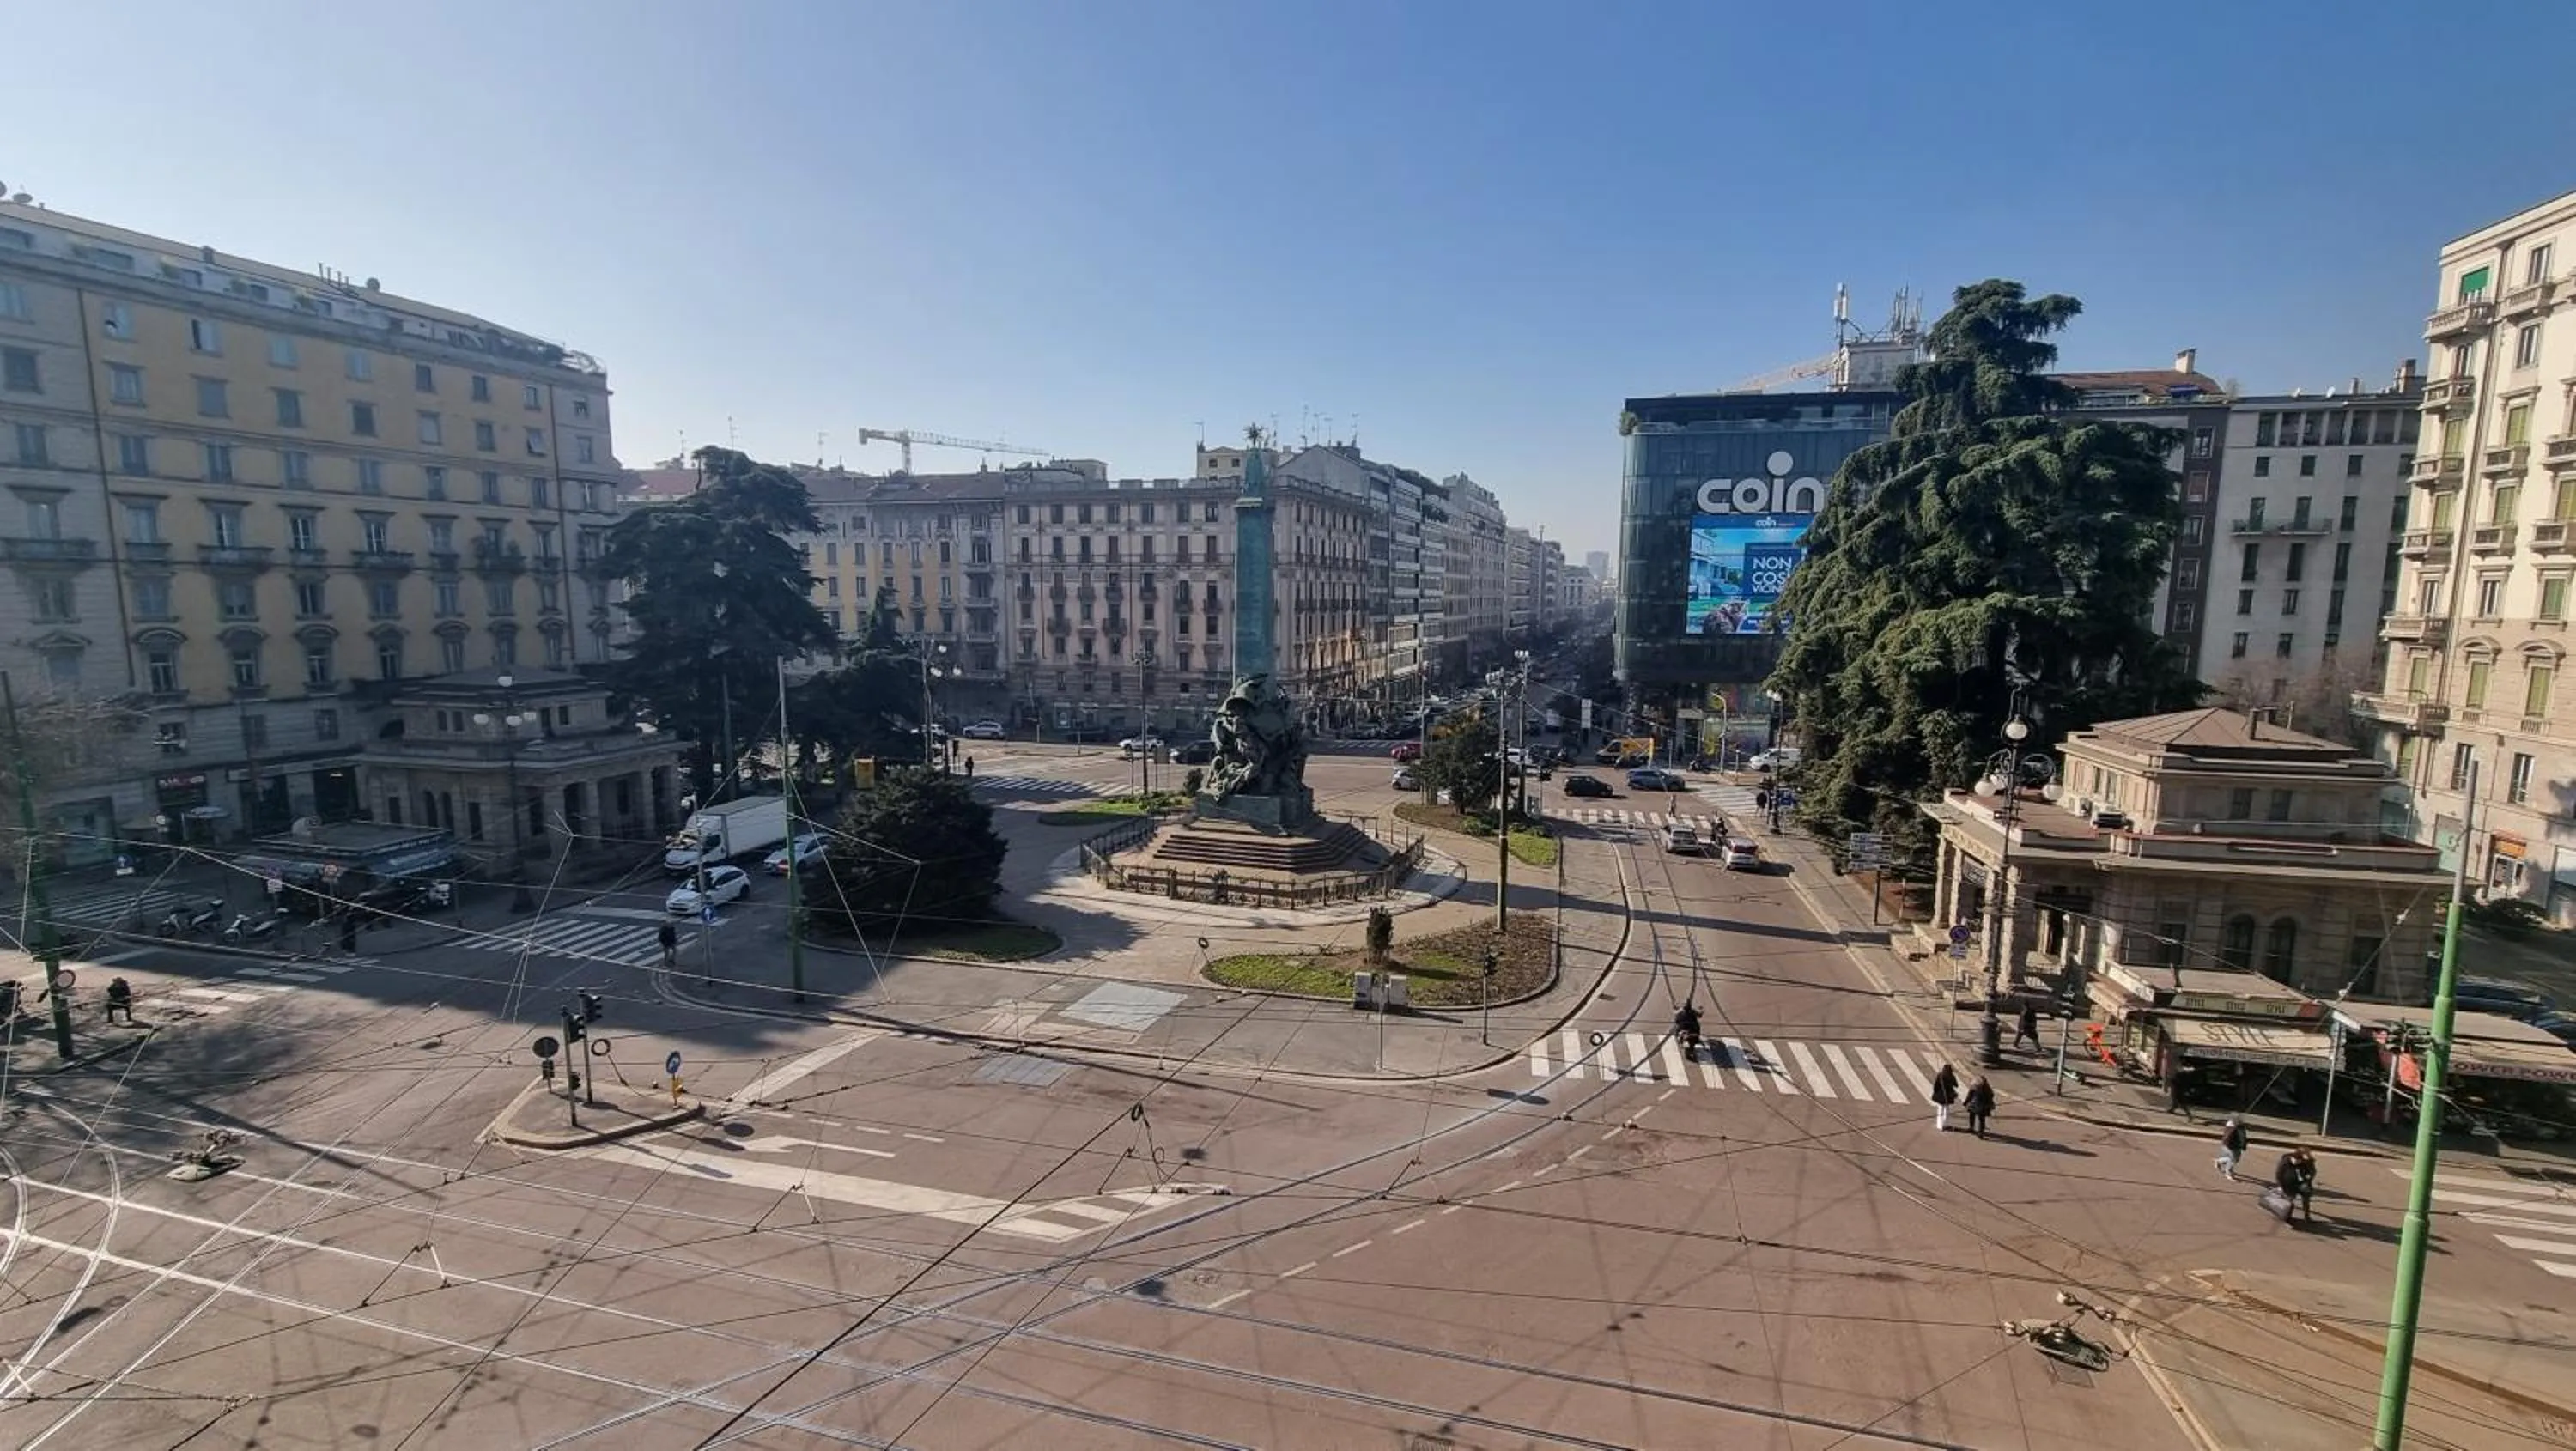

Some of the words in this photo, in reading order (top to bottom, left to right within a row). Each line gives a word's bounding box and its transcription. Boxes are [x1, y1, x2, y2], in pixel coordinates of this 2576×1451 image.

[1697, 451, 1825, 513] coin
[1755, 516, 1777, 527] coin
[1753, 556, 1792, 569] NON
[2199, 1023, 2279, 1047] STYLE
[2453, 1061, 2513, 1074] OWER
